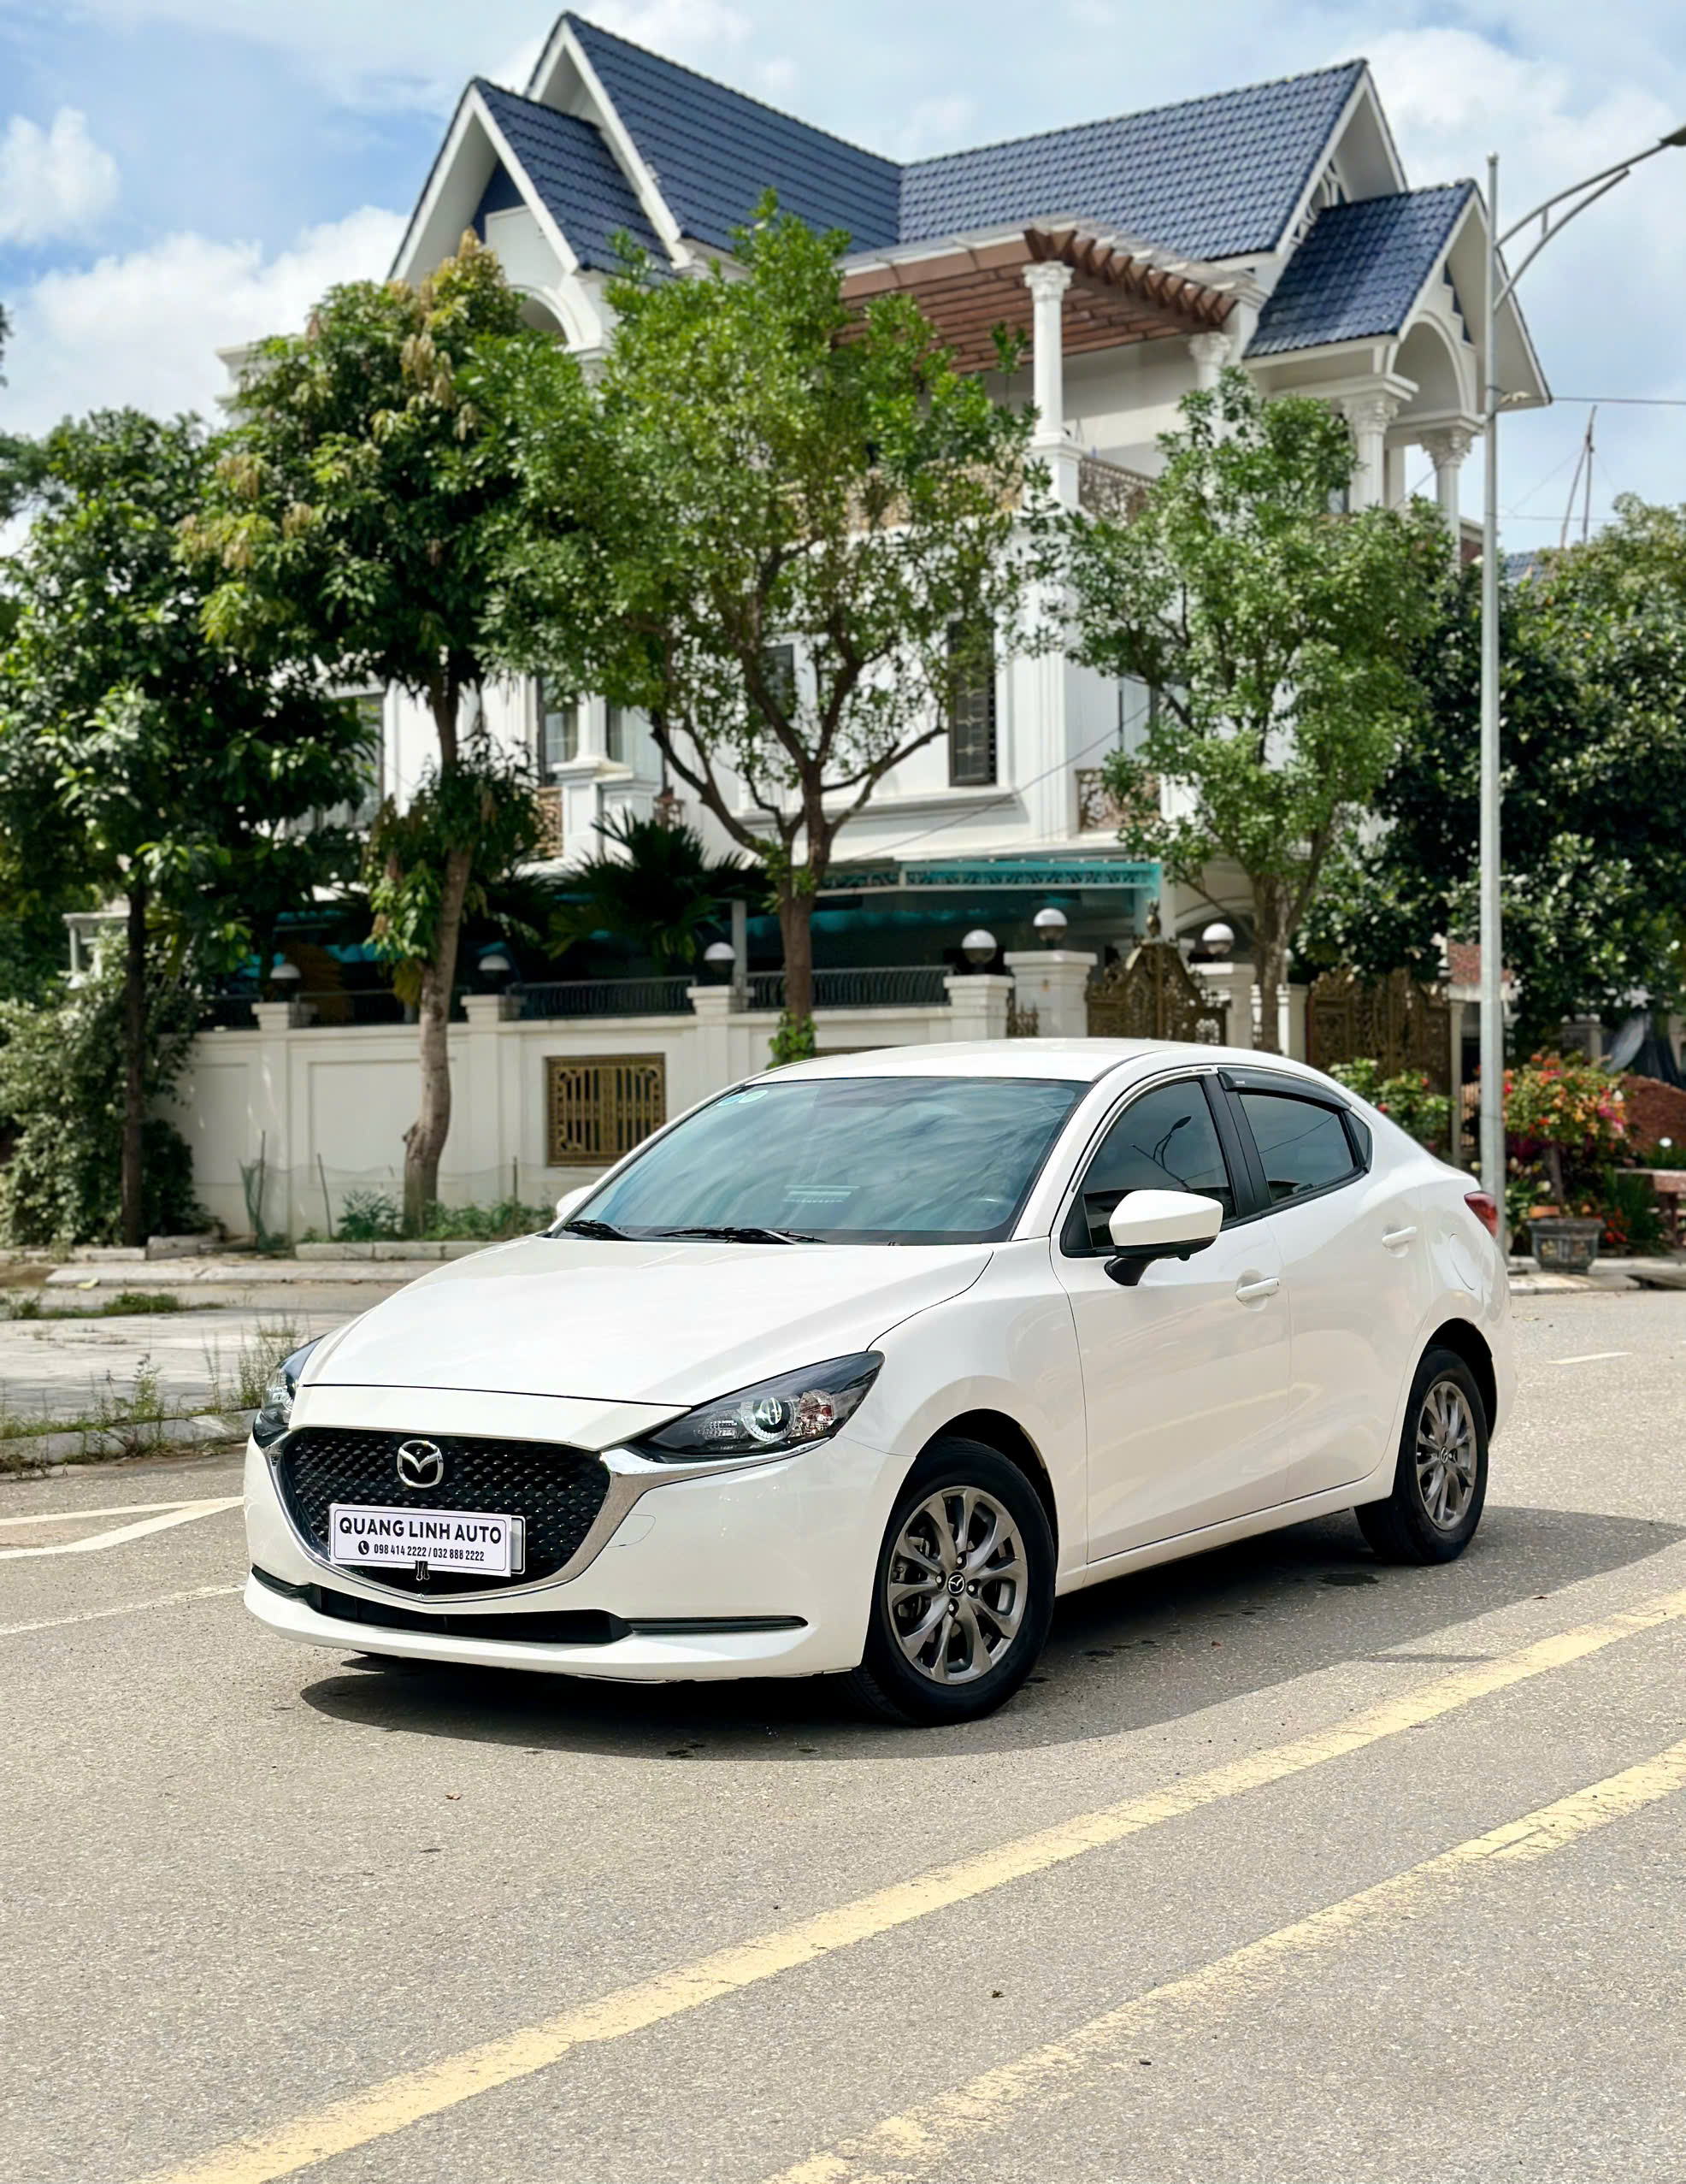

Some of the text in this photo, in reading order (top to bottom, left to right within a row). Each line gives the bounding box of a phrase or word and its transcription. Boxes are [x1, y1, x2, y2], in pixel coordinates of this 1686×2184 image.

[339, 1517, 502, 1544] QUANG LINH AUTO
[374, 1544, 389, 1555] 098
[390, 1544, 405, 1555] 414
[407, 1545, 427, 1557] 2222
[433, 1548, 448, 1559] 032
[449, 1549, 464, 1560] 888
[465, 1549, 485, 1561] 2222
